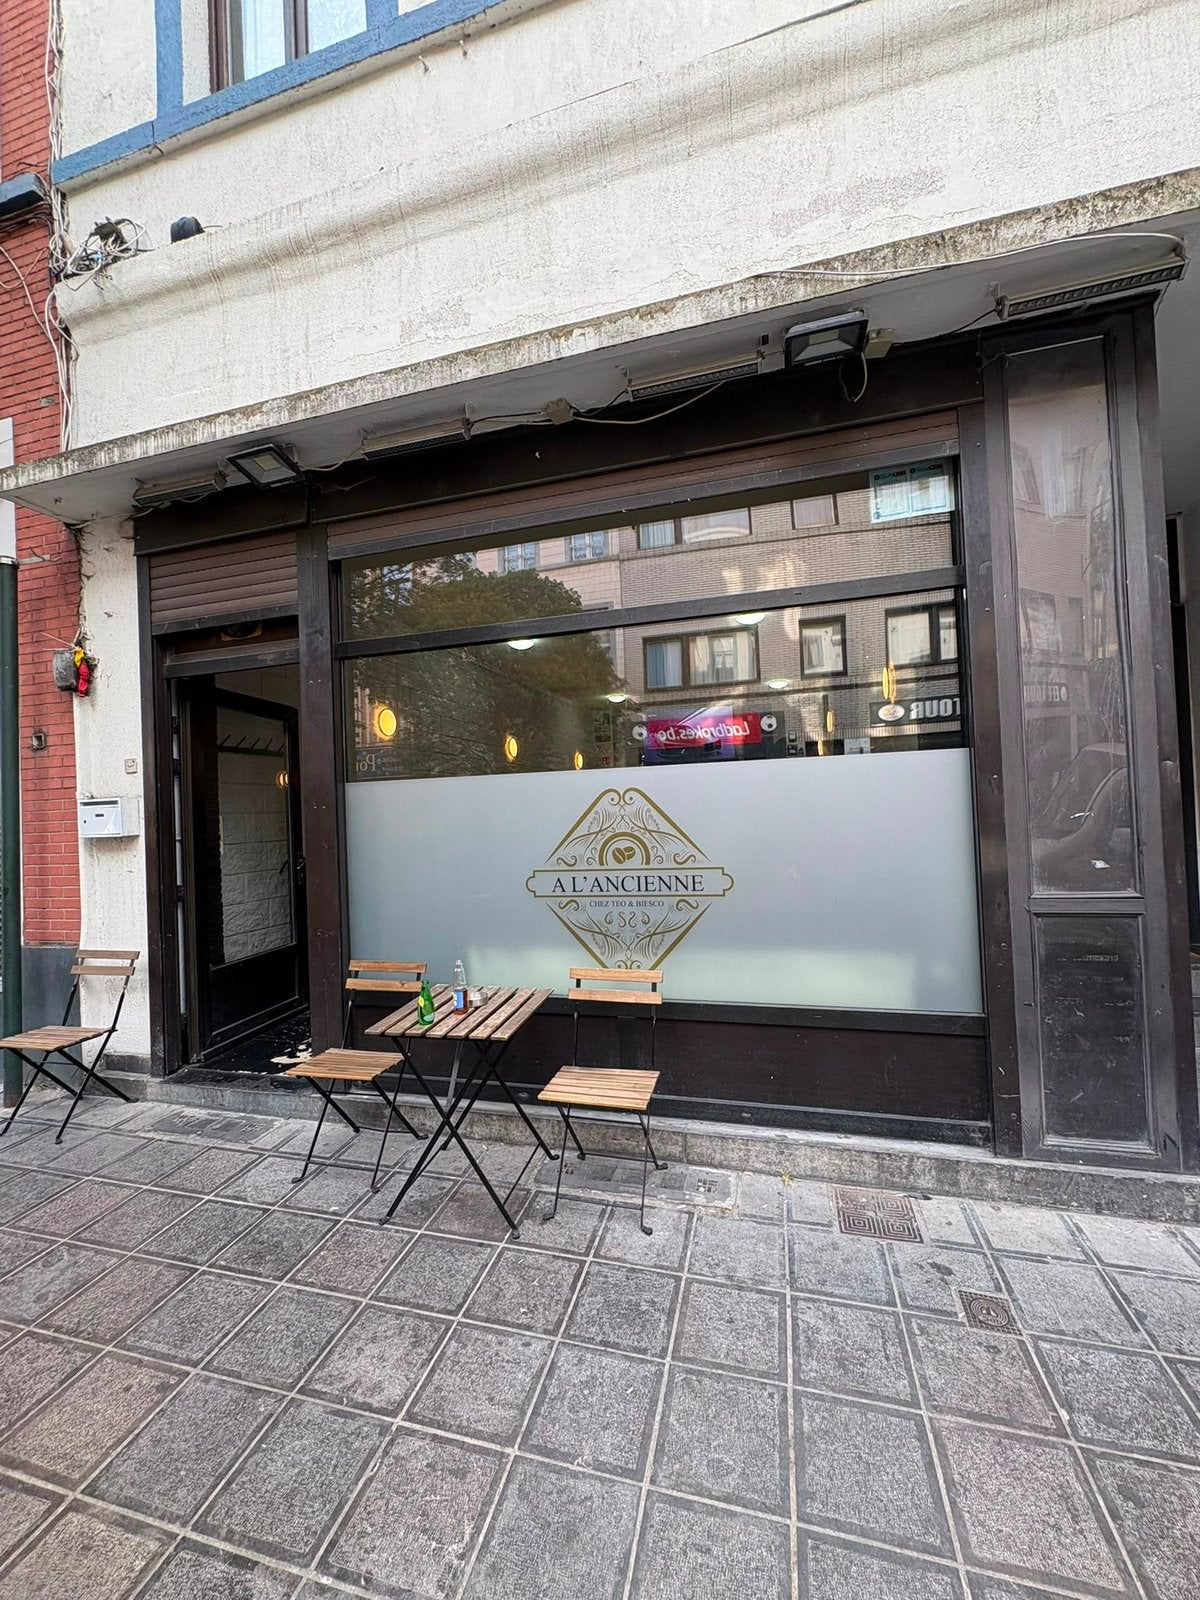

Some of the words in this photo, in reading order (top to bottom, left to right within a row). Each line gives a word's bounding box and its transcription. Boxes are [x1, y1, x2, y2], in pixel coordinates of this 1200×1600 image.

[552, 876, 566, 893] A
[571, 875, 705, 893] L'ANCIENNE
[589, 900, 609, 908] CHEZ
[612, 900, 626, 908] TEO
[628, 900, 634, 908] &
[636, 900, 664, 908] BIESCO
